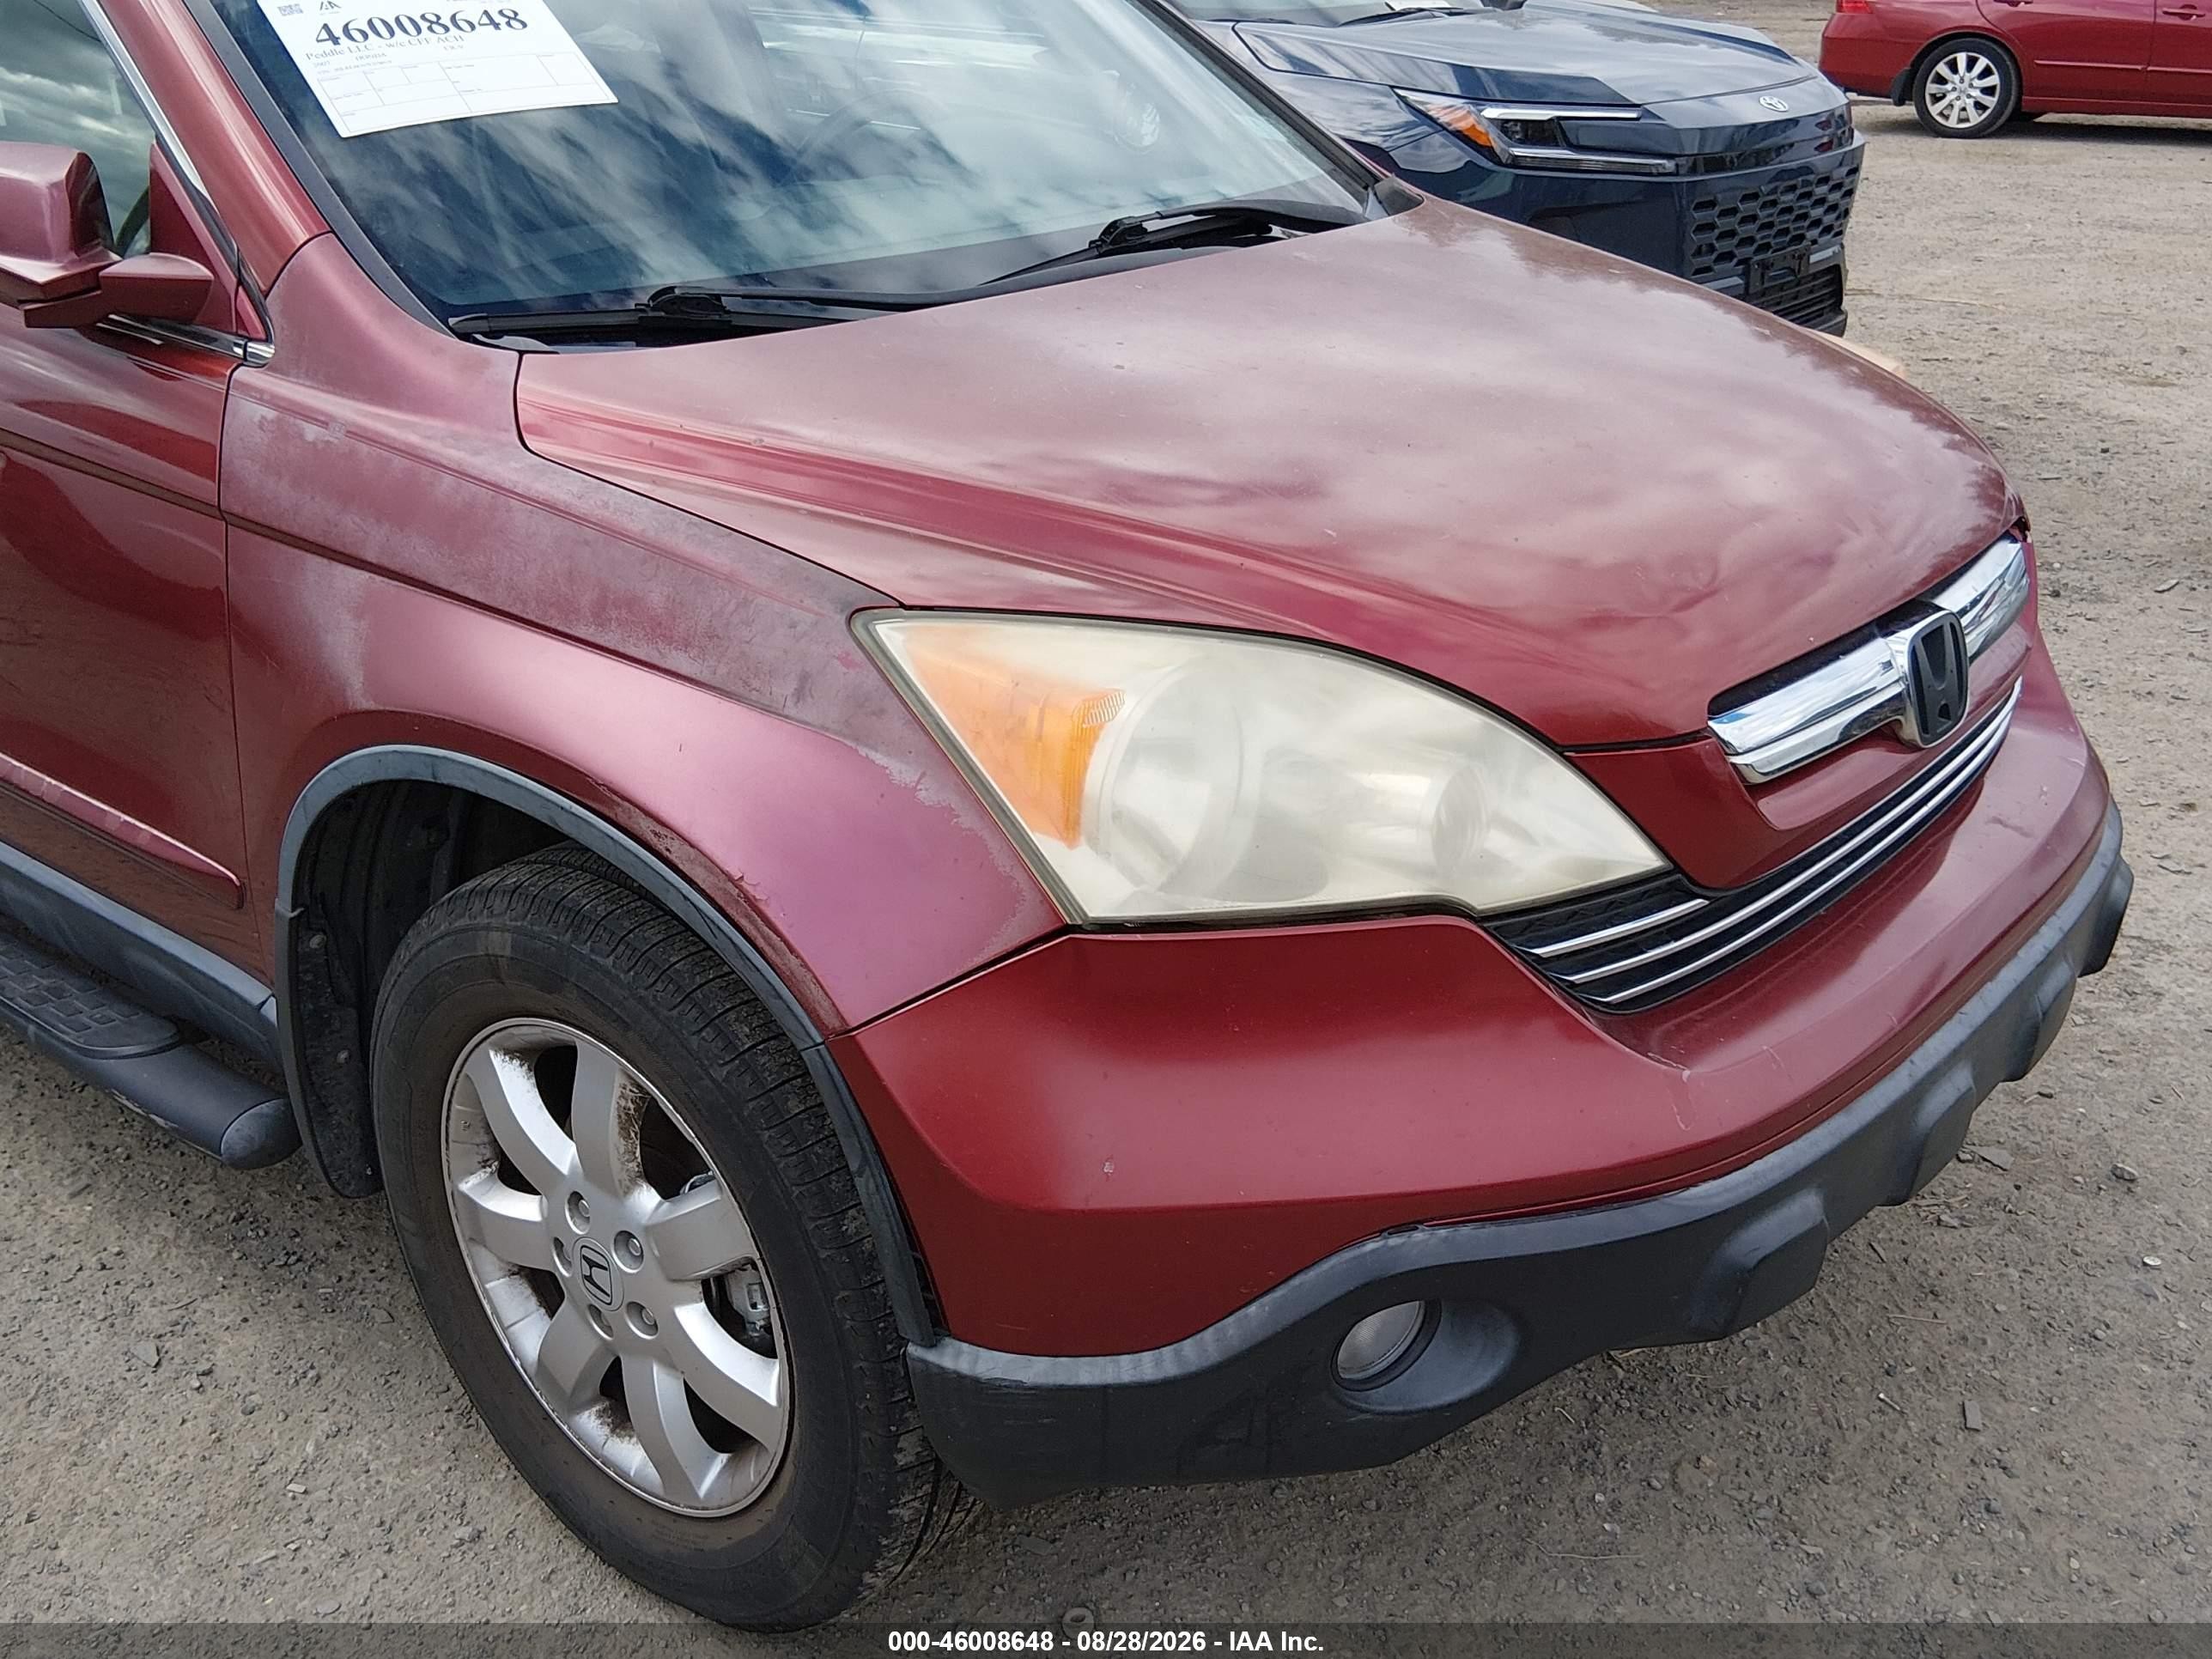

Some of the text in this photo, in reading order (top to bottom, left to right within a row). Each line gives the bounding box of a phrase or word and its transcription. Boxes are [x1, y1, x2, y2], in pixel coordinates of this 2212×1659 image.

[315, 8, 528, 46] 46008648
[305, 48, 345, 60] Peddle
[347, 44, 374, 54] LLC
